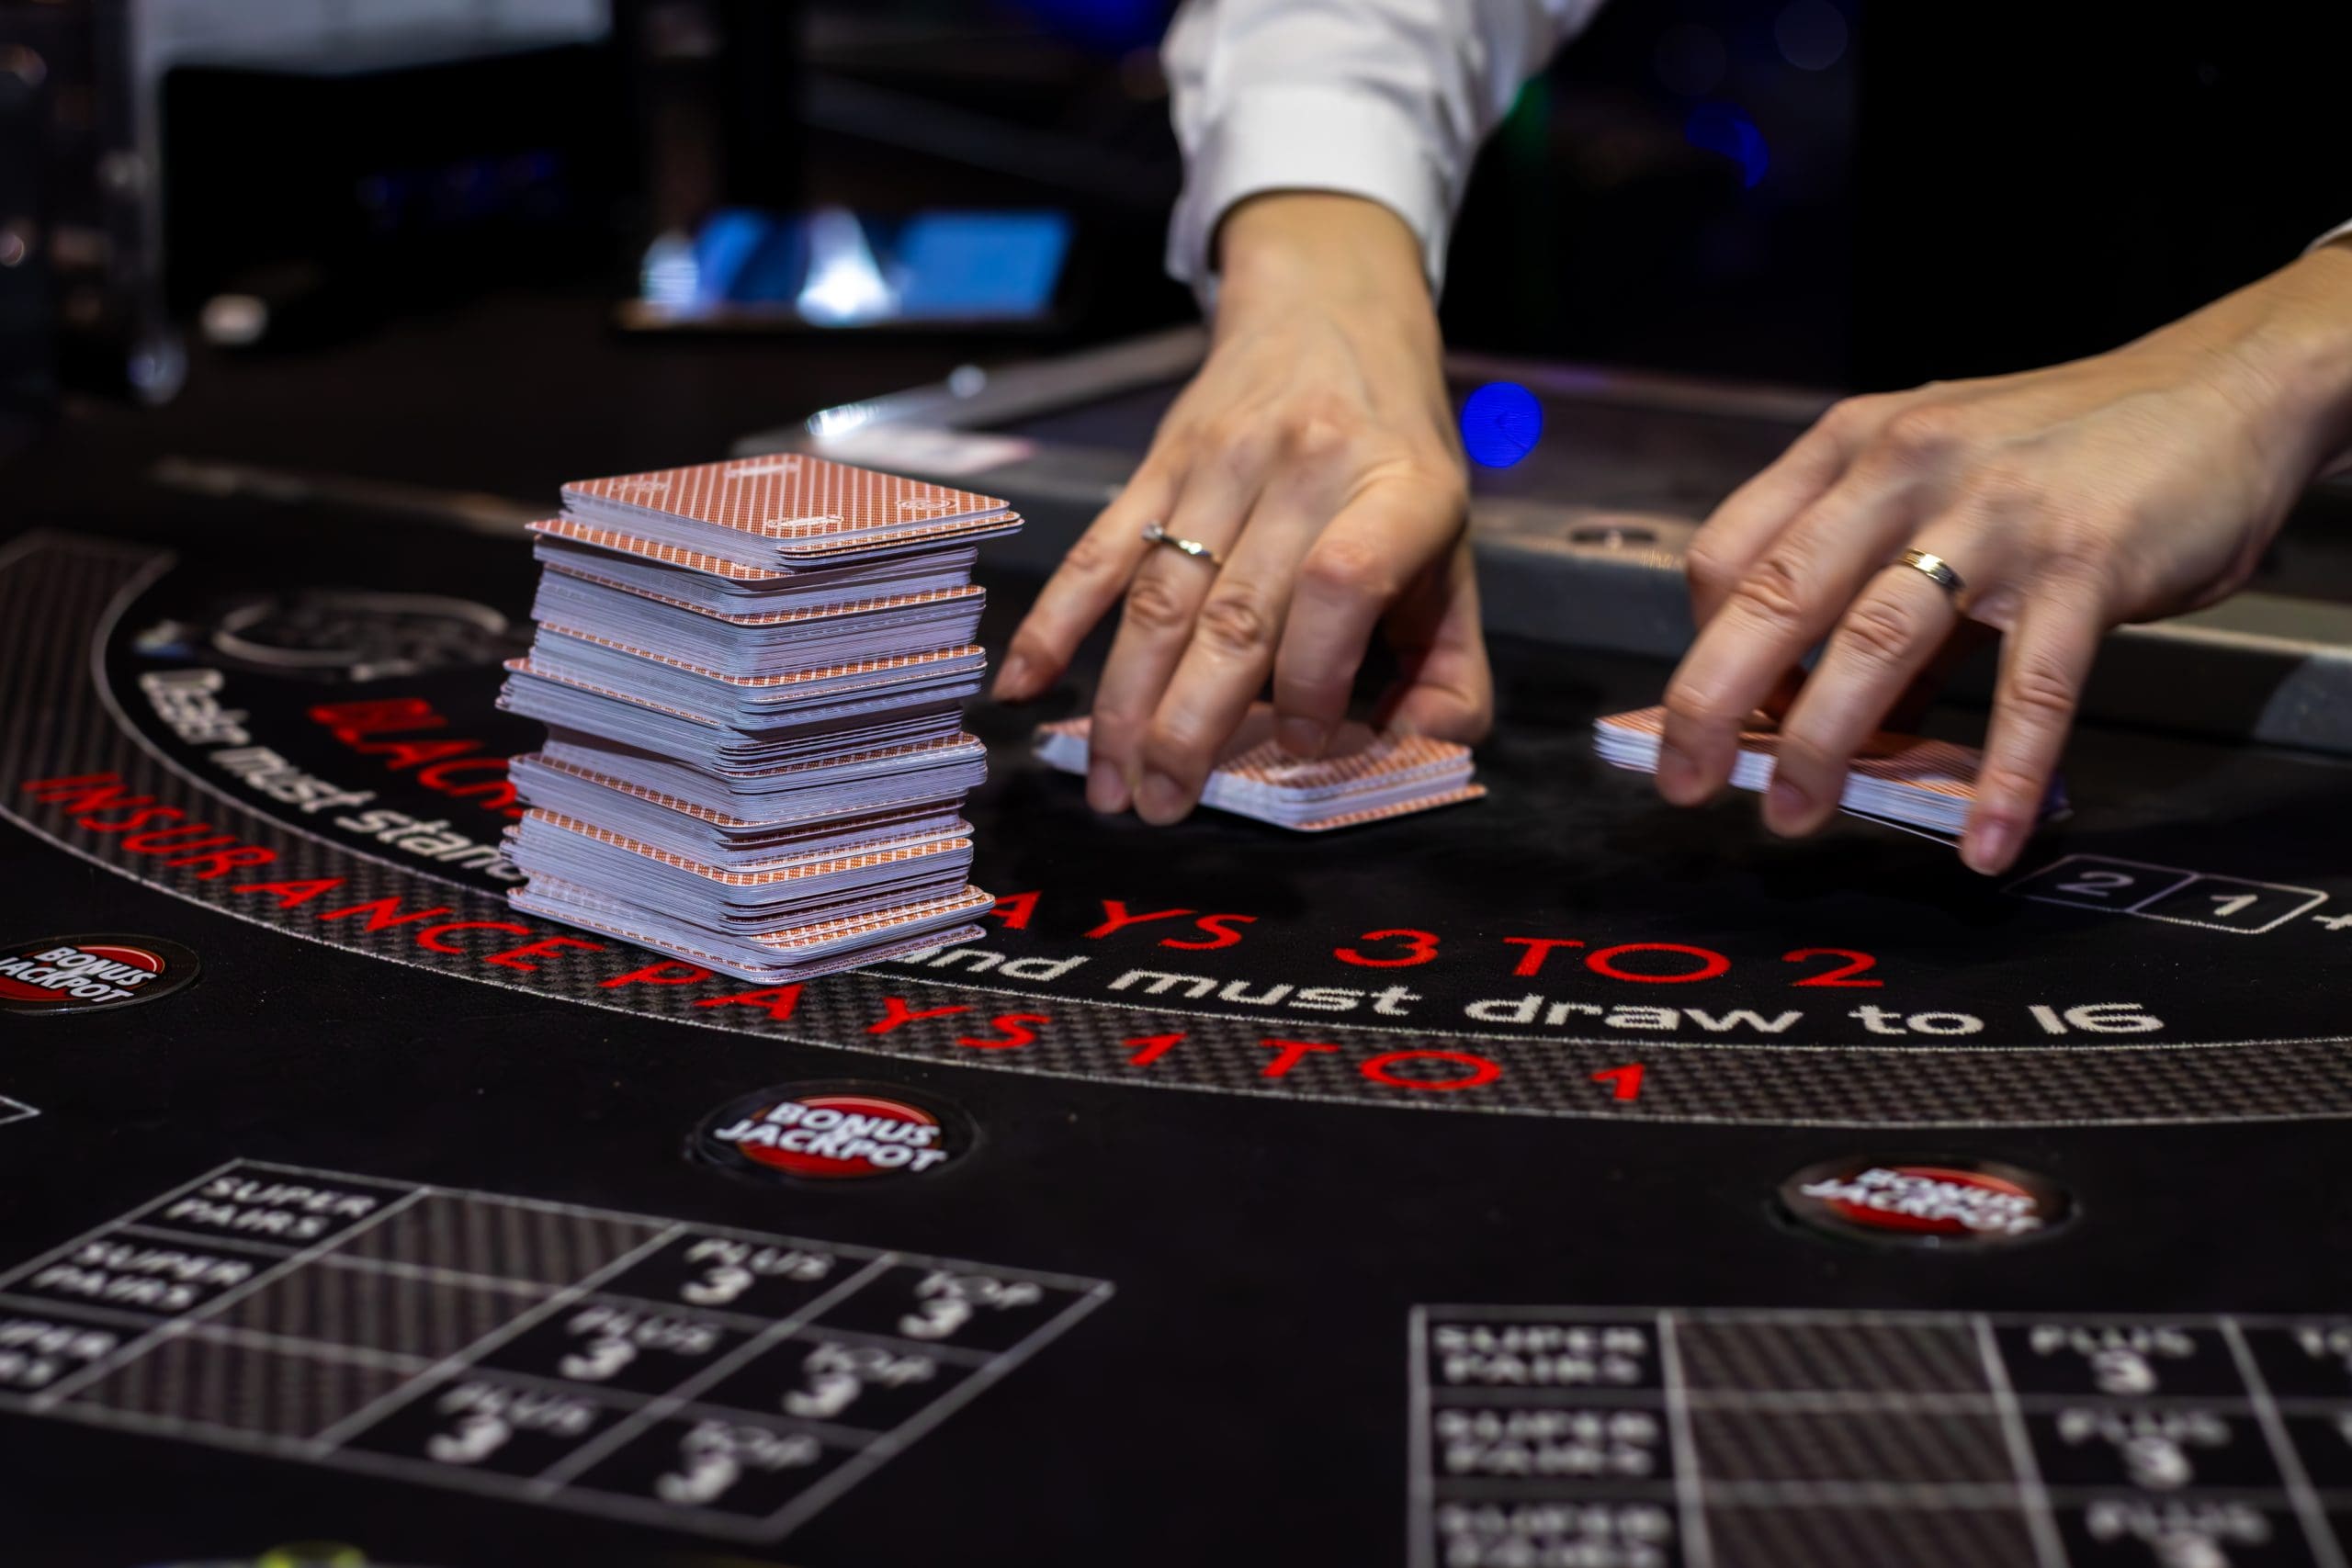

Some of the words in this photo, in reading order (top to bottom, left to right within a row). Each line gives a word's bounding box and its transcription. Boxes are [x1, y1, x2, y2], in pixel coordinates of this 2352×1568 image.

[2057, 872, 2135, 897] 2
[20, 772, 605, 972] INSURANCE
[599, 958, 1051, 1051] PAYS
[1123, 1032, 1188, 1066] 1
[1260, 1038, 1501, 1090] TO
[1591, 1063, 1645, 1101] 1
[989, 888, 1257, 950] AYS
[1334, 929, 1440, 967] 3
[1503, 937, 1731, 984] TO
[1781, 947, 1884, 988] 2
[34, 946, 157, 987] BONUS
[1106, 968, 1422, 1017] must
[1464, 992, 1804, 1034] draw
[1849, 1004, 1984, 1035] to
[714, 1118, 948, 1172] JACKPOT
[765, 1101, 941, 1146] BONUS
[165, 1198, 329, 1238] PAIRS
[199, 1176, 378, 1217] SUPER
